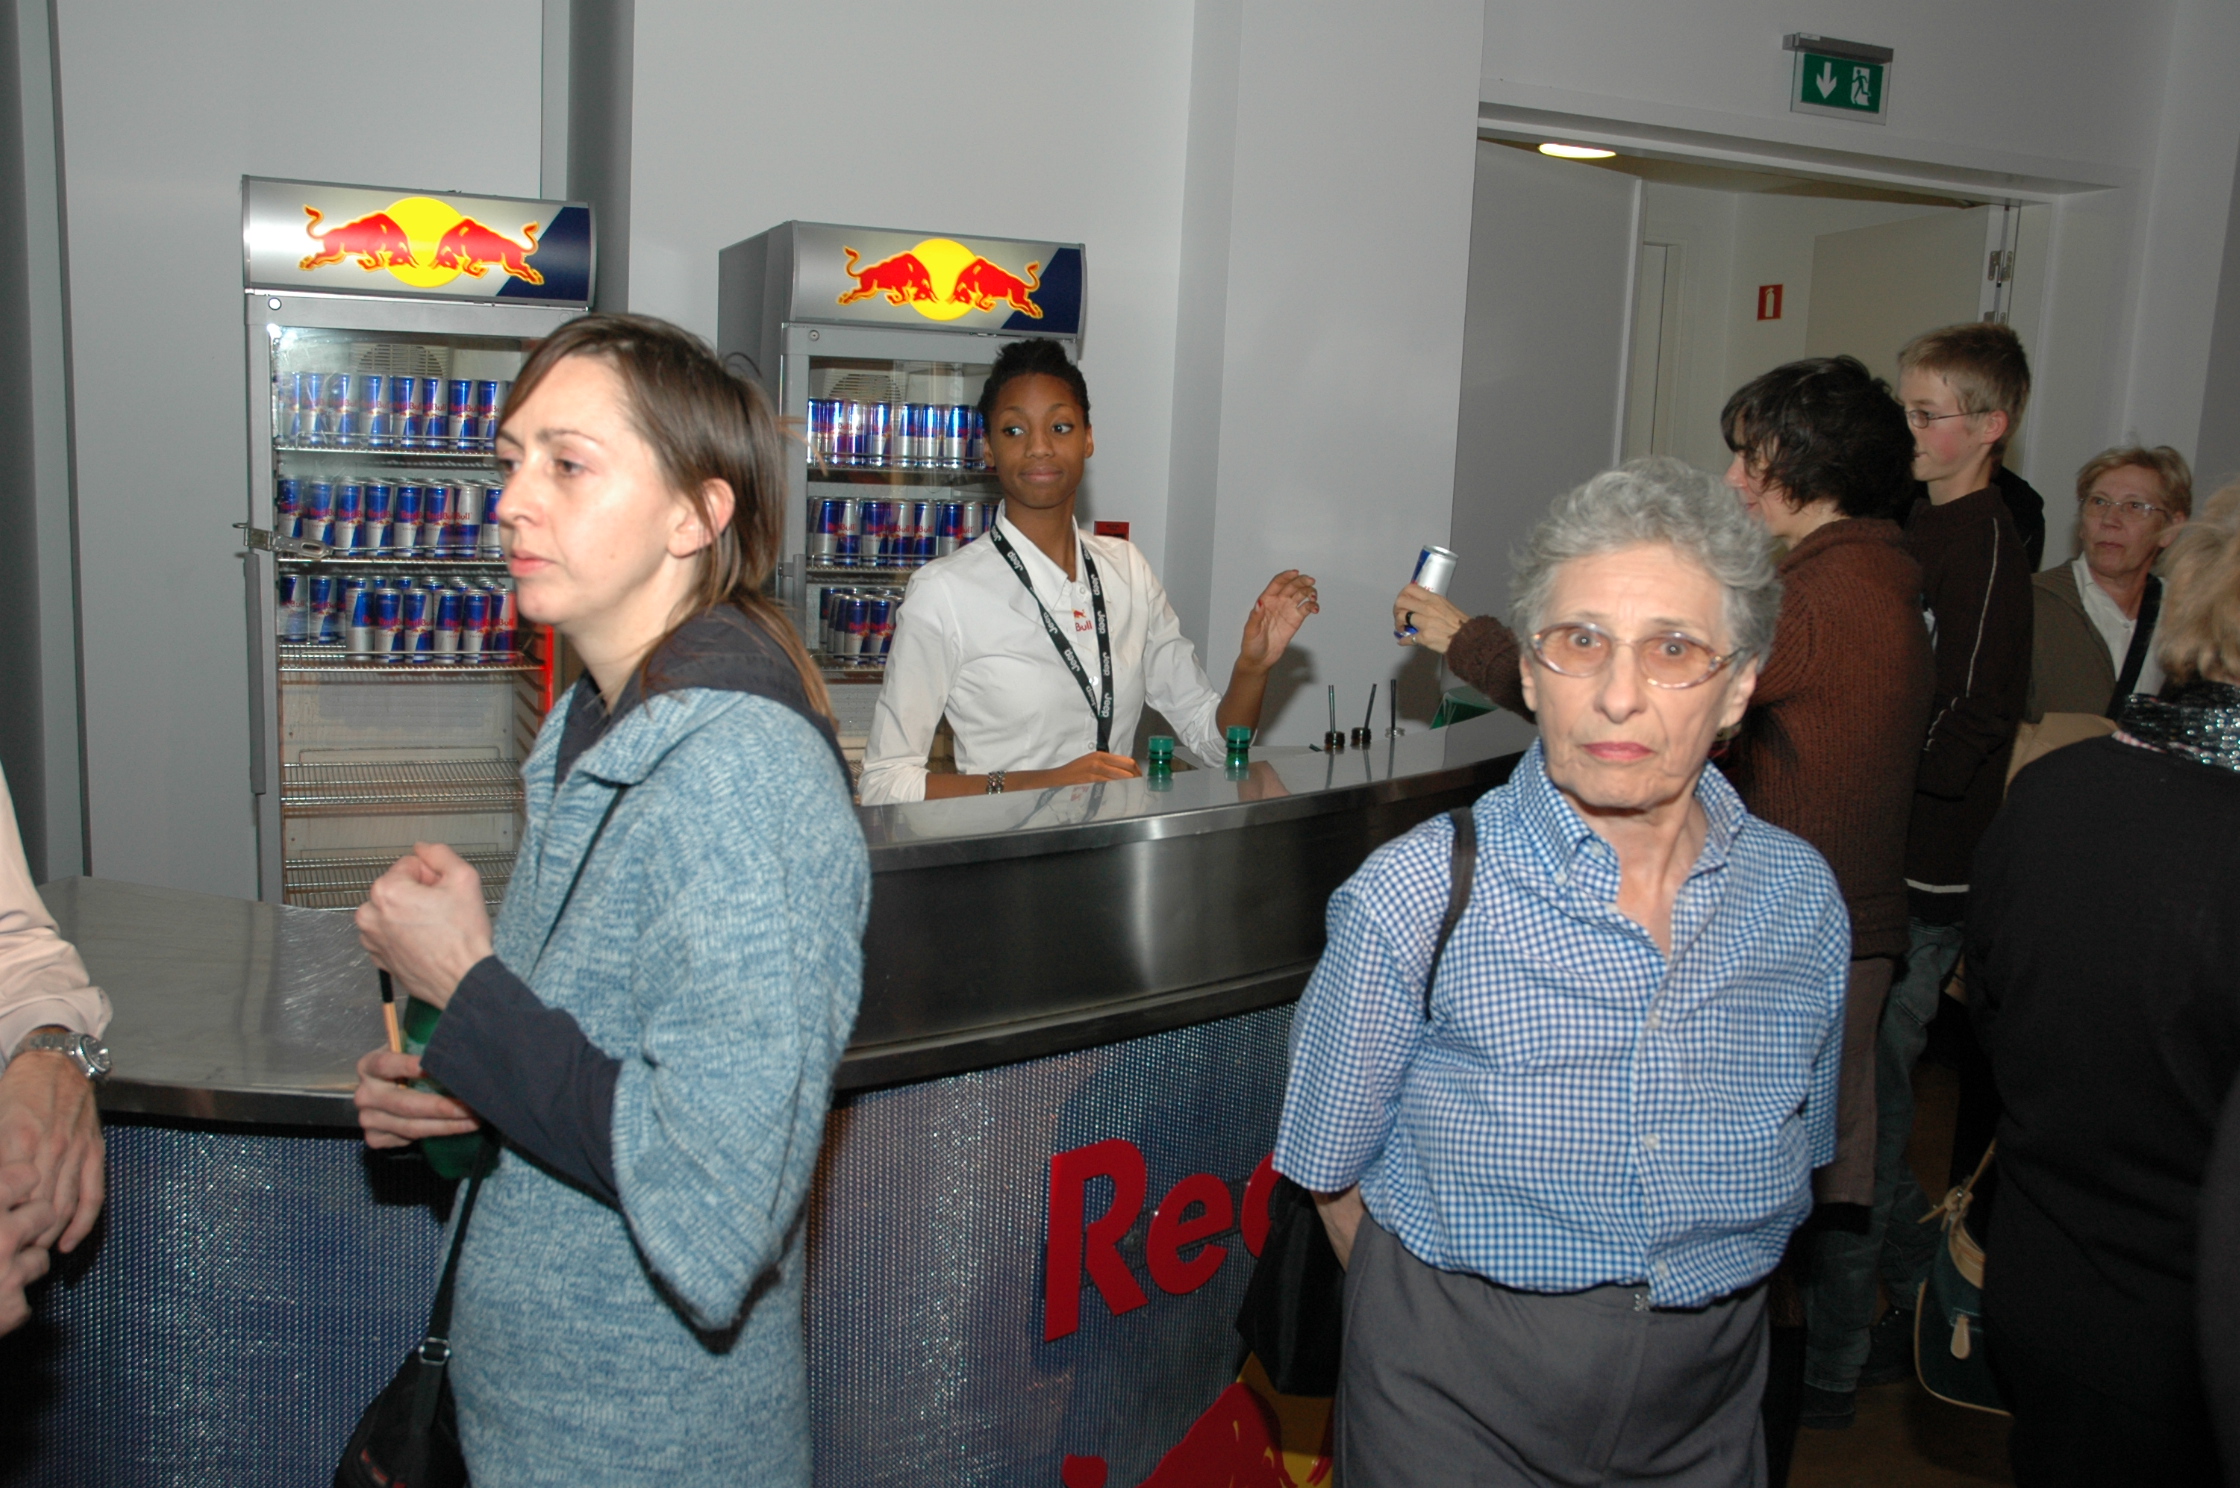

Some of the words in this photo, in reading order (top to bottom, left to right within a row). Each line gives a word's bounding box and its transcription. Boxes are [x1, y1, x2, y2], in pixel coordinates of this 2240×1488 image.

[1007, 549, 1024, 571] Jeep
[1090, 573, 1101, 596] Jeep
[1075, 620, 1093, 632] Bull
[1097, 610, 1106, 635] Jeep
[1064, 648, 1080, 672] Jeep
[1102, 651, 1111, 676] Jeep
[1102, 692, 1112, 718] Jeep
